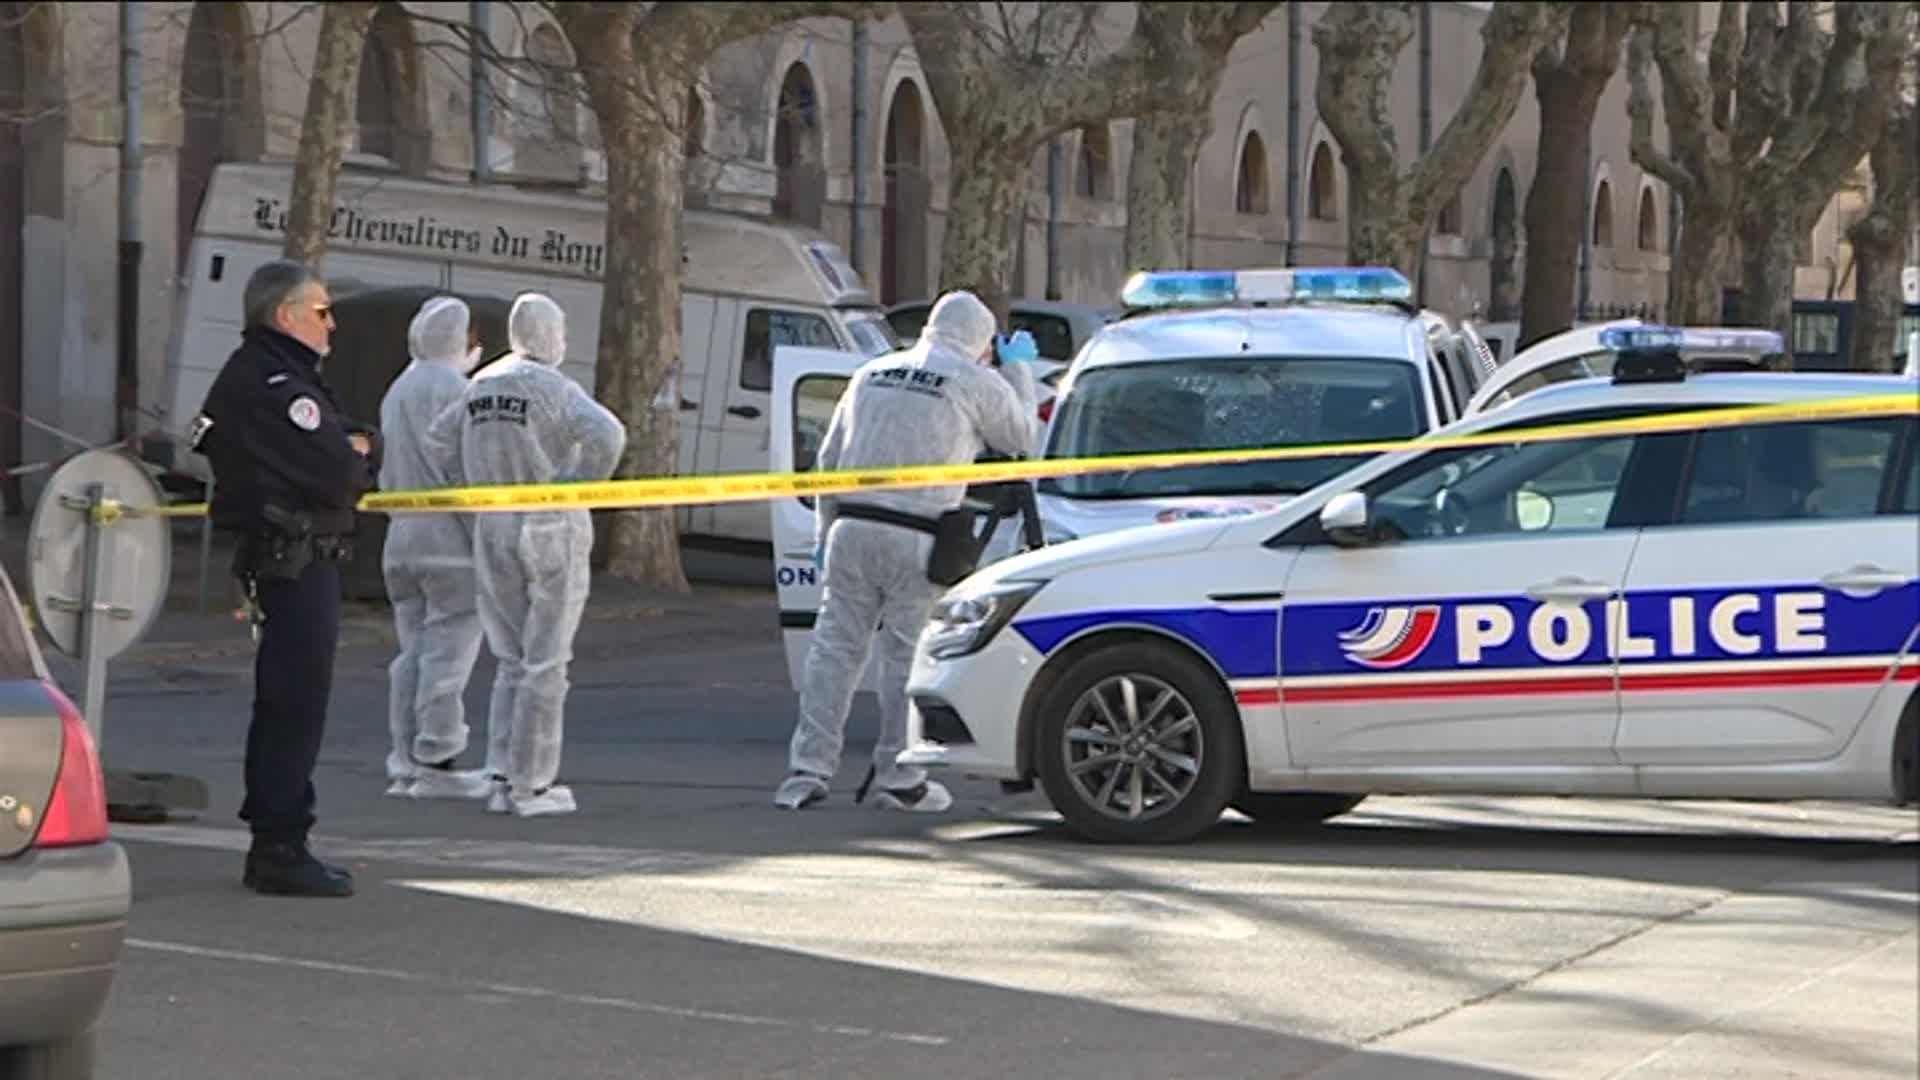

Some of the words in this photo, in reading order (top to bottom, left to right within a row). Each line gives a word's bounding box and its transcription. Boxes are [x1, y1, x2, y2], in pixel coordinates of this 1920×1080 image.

[327, 207, 481, 253] Chevaliers
[492, 225, 529, 258] du
[1455, 592, 1827, 664] POLICE
